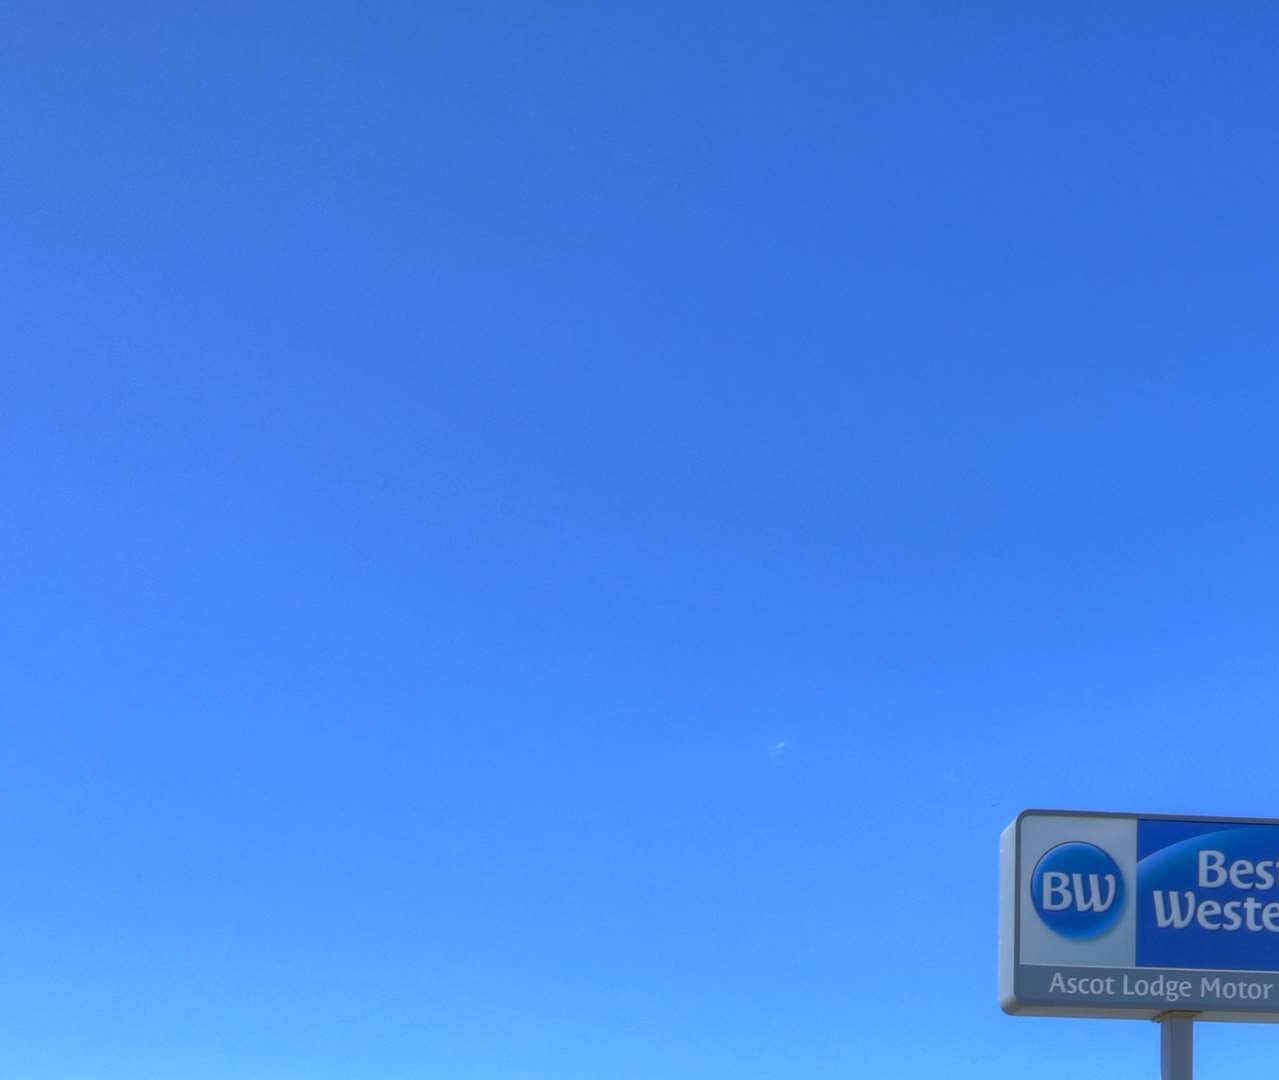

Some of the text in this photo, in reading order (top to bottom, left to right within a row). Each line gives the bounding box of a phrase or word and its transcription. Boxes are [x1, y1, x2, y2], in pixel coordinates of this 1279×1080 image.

[1042, 871, 1116, 912] BW
[1049, 972, 1115, 995] Ascot
[1122, 974, 1193, 1001] Lodge
[1200, 977, 1273, 1000] Motor
